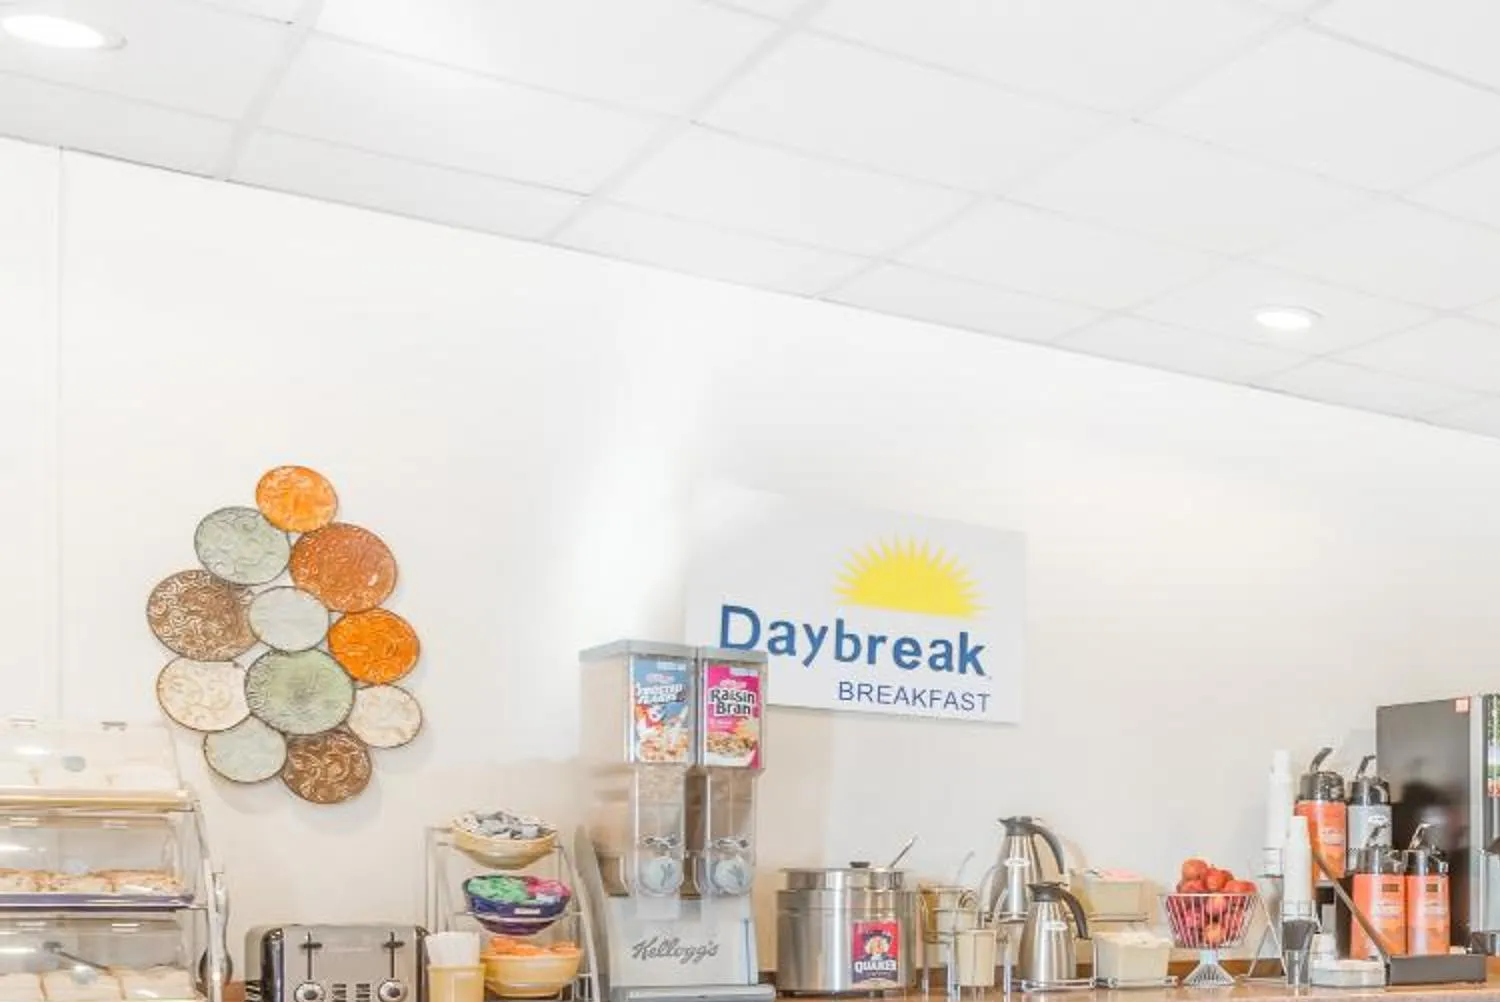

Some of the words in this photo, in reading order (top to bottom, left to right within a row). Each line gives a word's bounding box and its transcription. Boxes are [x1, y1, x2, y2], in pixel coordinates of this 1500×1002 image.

[719, 604, 986, 676] Daybreak
[710, 689, 755, 704] Raisin
[715, 701, 751, 715] Bran
[838, 681, 991, 713] BREAKFAST
[632, 937, 719, 964] Kellogg's
